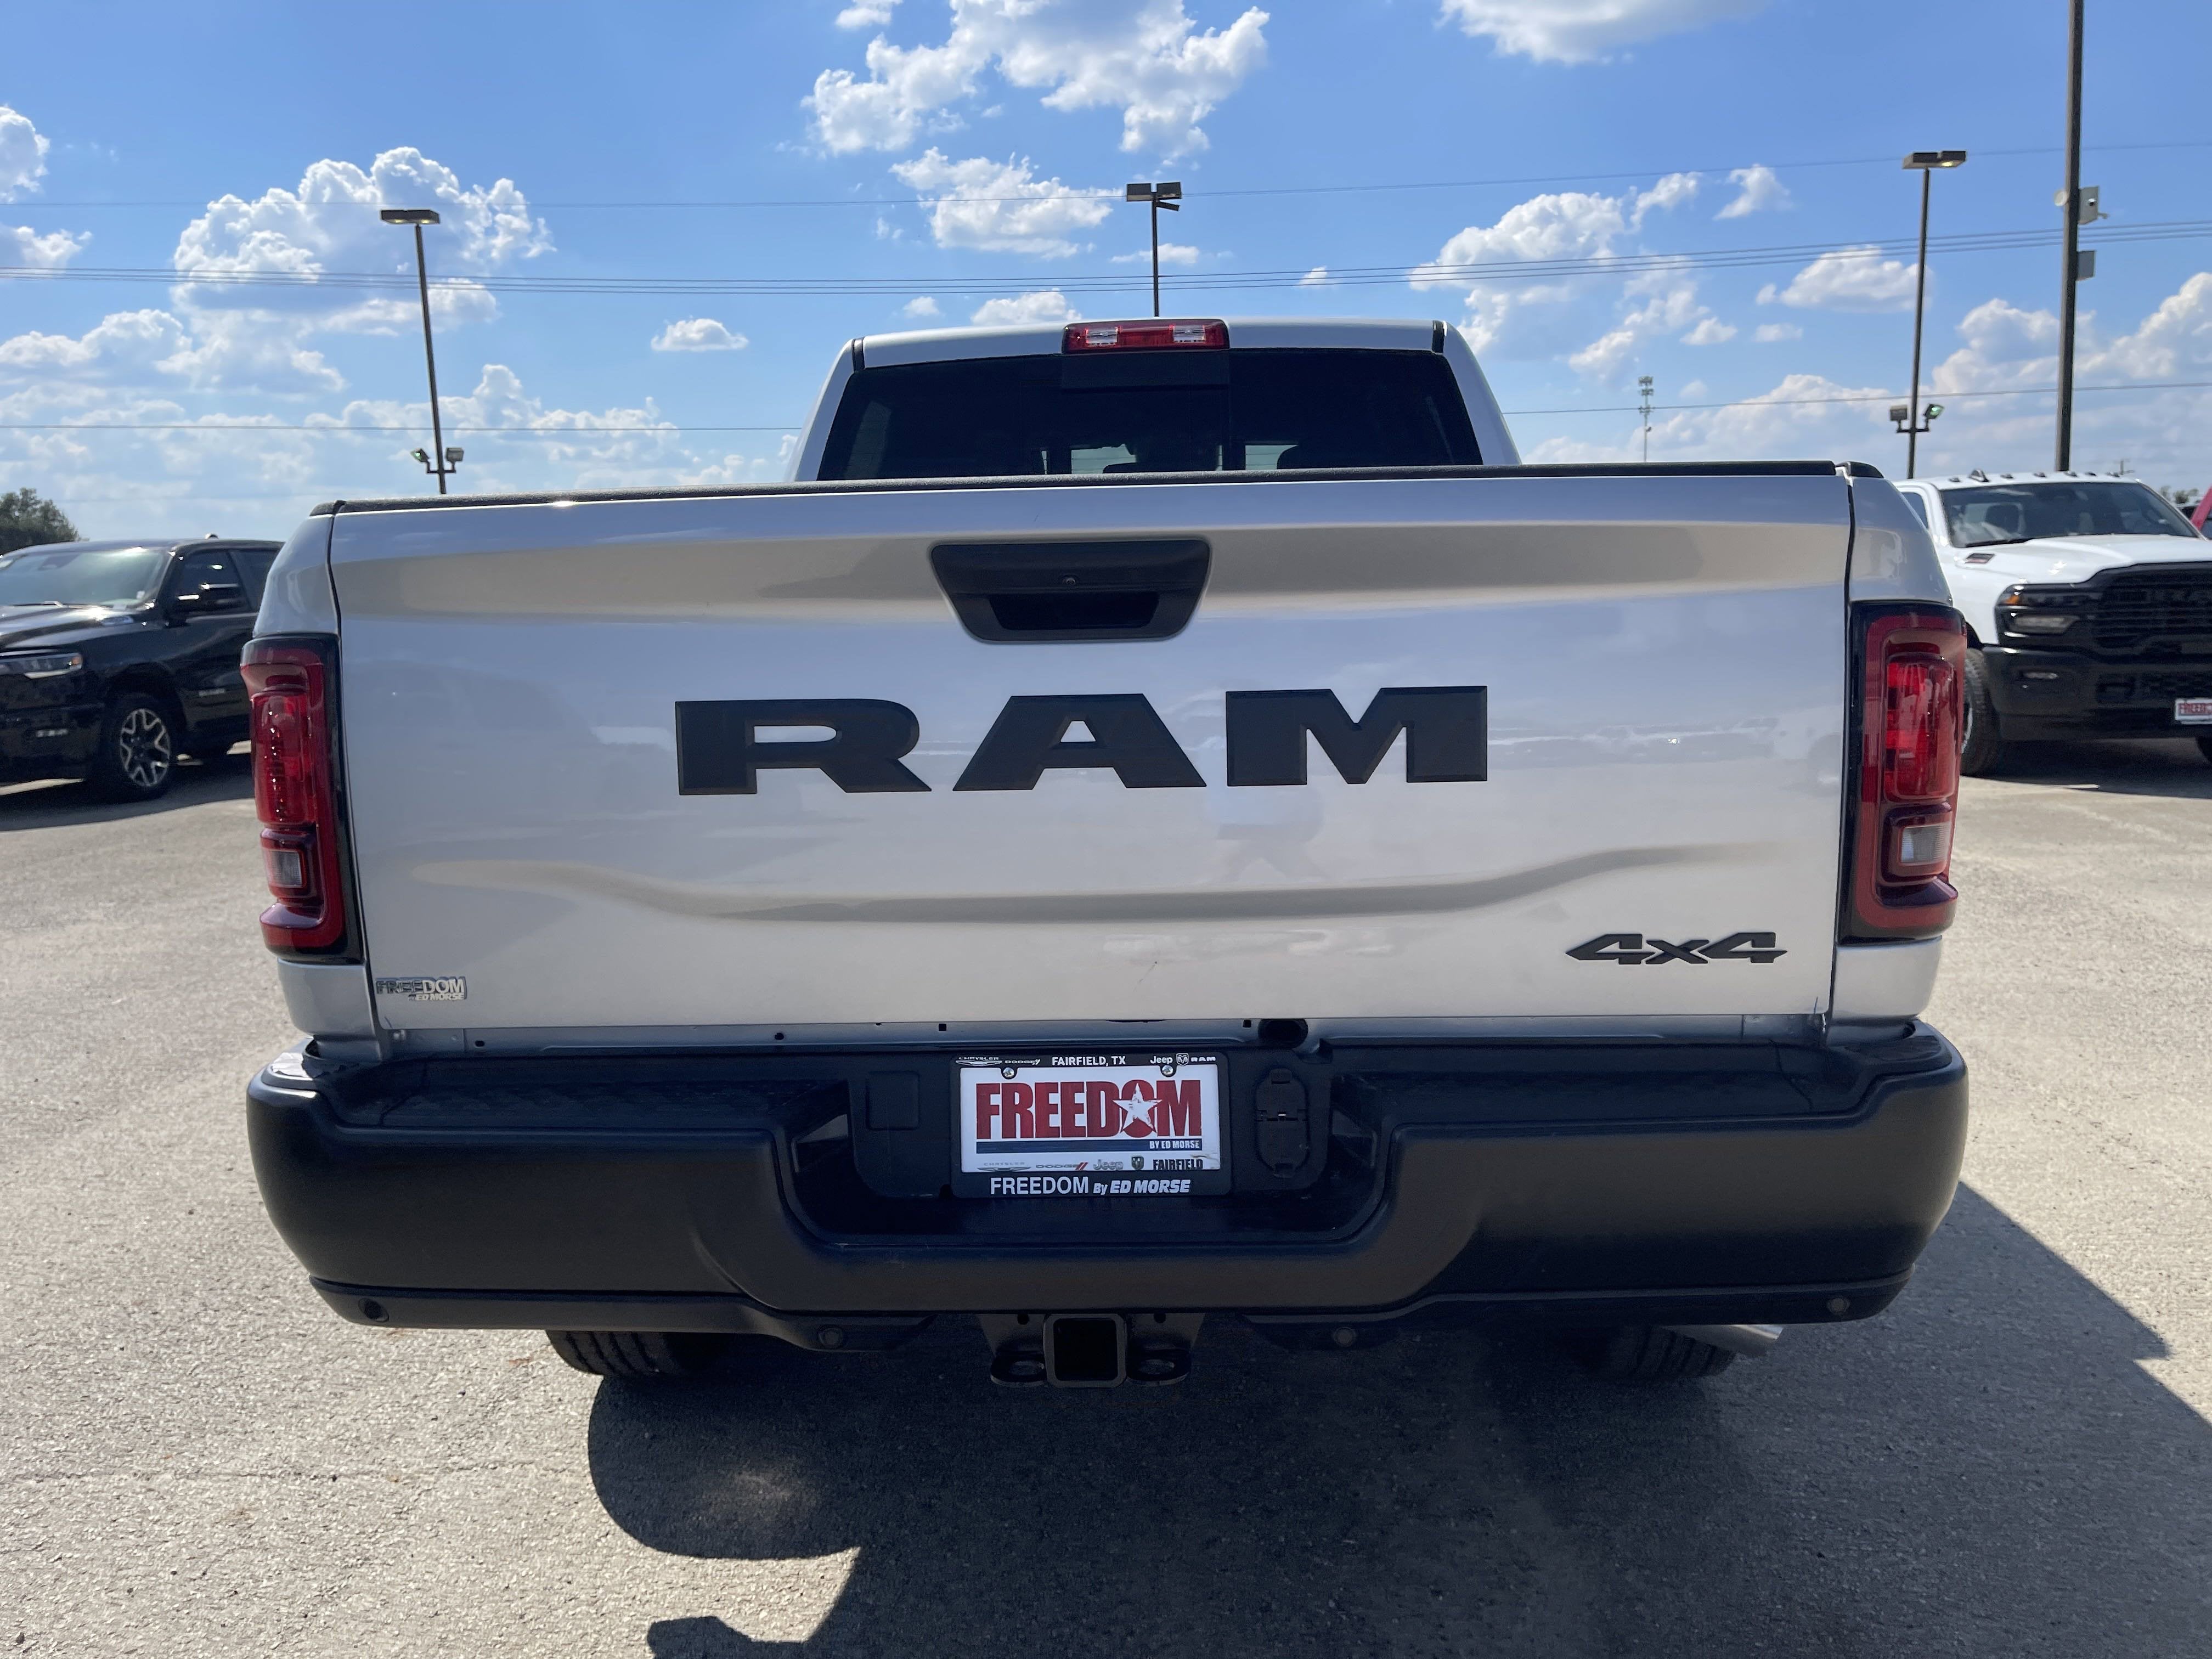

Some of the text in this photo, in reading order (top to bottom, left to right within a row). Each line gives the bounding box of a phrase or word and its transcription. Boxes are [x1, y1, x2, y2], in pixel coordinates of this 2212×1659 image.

[675, 686, 1488, 795] RAM
[1566, 932, 1788, 965] 4x4
[375, 978, 465, 994] FREEDOM
[1052, 1056, 1126, 1066] FAIRFIELD, TX
[1150, 1056, 1173, 1065] Jeep
[976, 1079, 1203, 1139] FREEDOM
[1172, 1140, 1199, 1148] MORSE
[1093, 1159, 1124, 1170] Jeep
[1153, 1159, 1203, 1170] FAIRFIELD
[990, 1177, 1190, 1195] FREEDOM By ED MORSE
